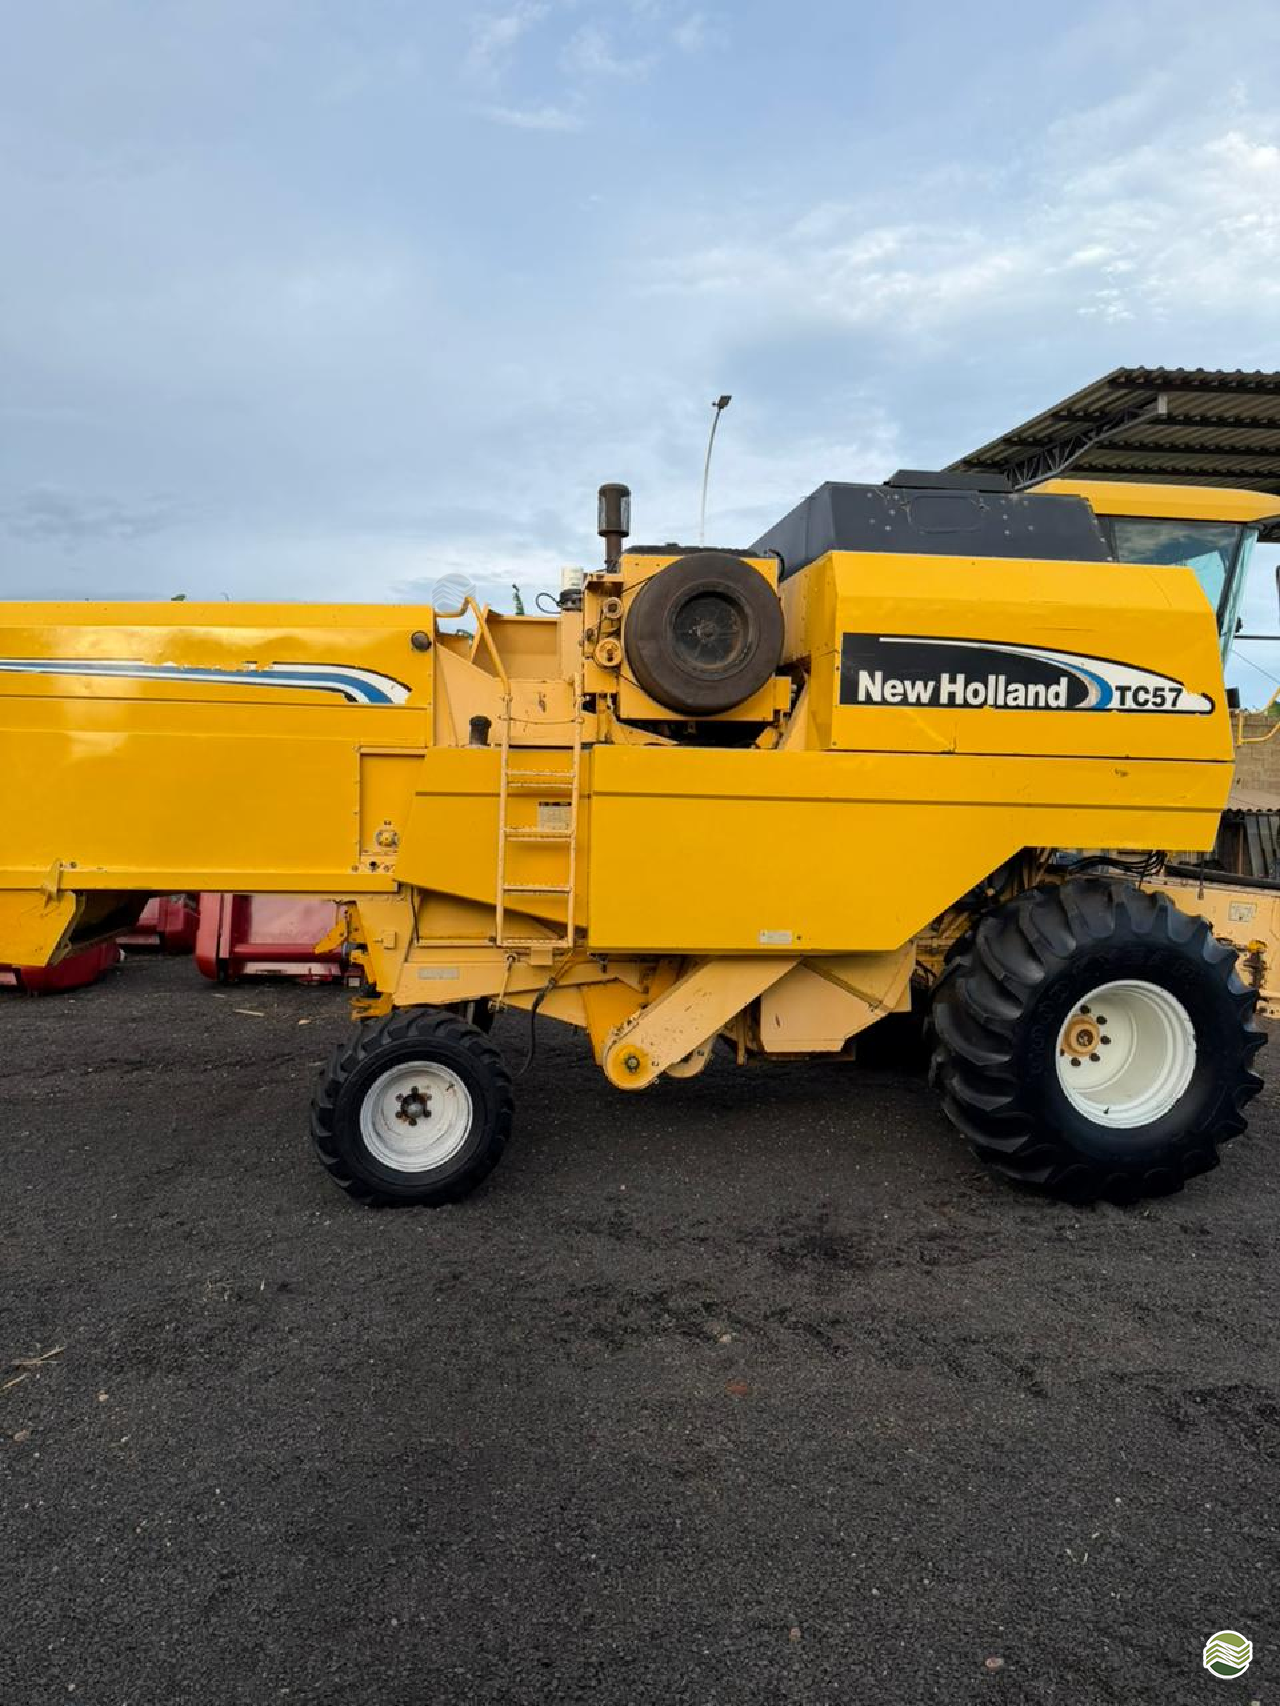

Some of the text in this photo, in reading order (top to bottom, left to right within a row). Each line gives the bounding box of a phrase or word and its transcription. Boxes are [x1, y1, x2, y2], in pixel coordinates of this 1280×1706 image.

[857, 670, 1068, 708] New Holland
[1115, 684, 1183, 708] TC57
